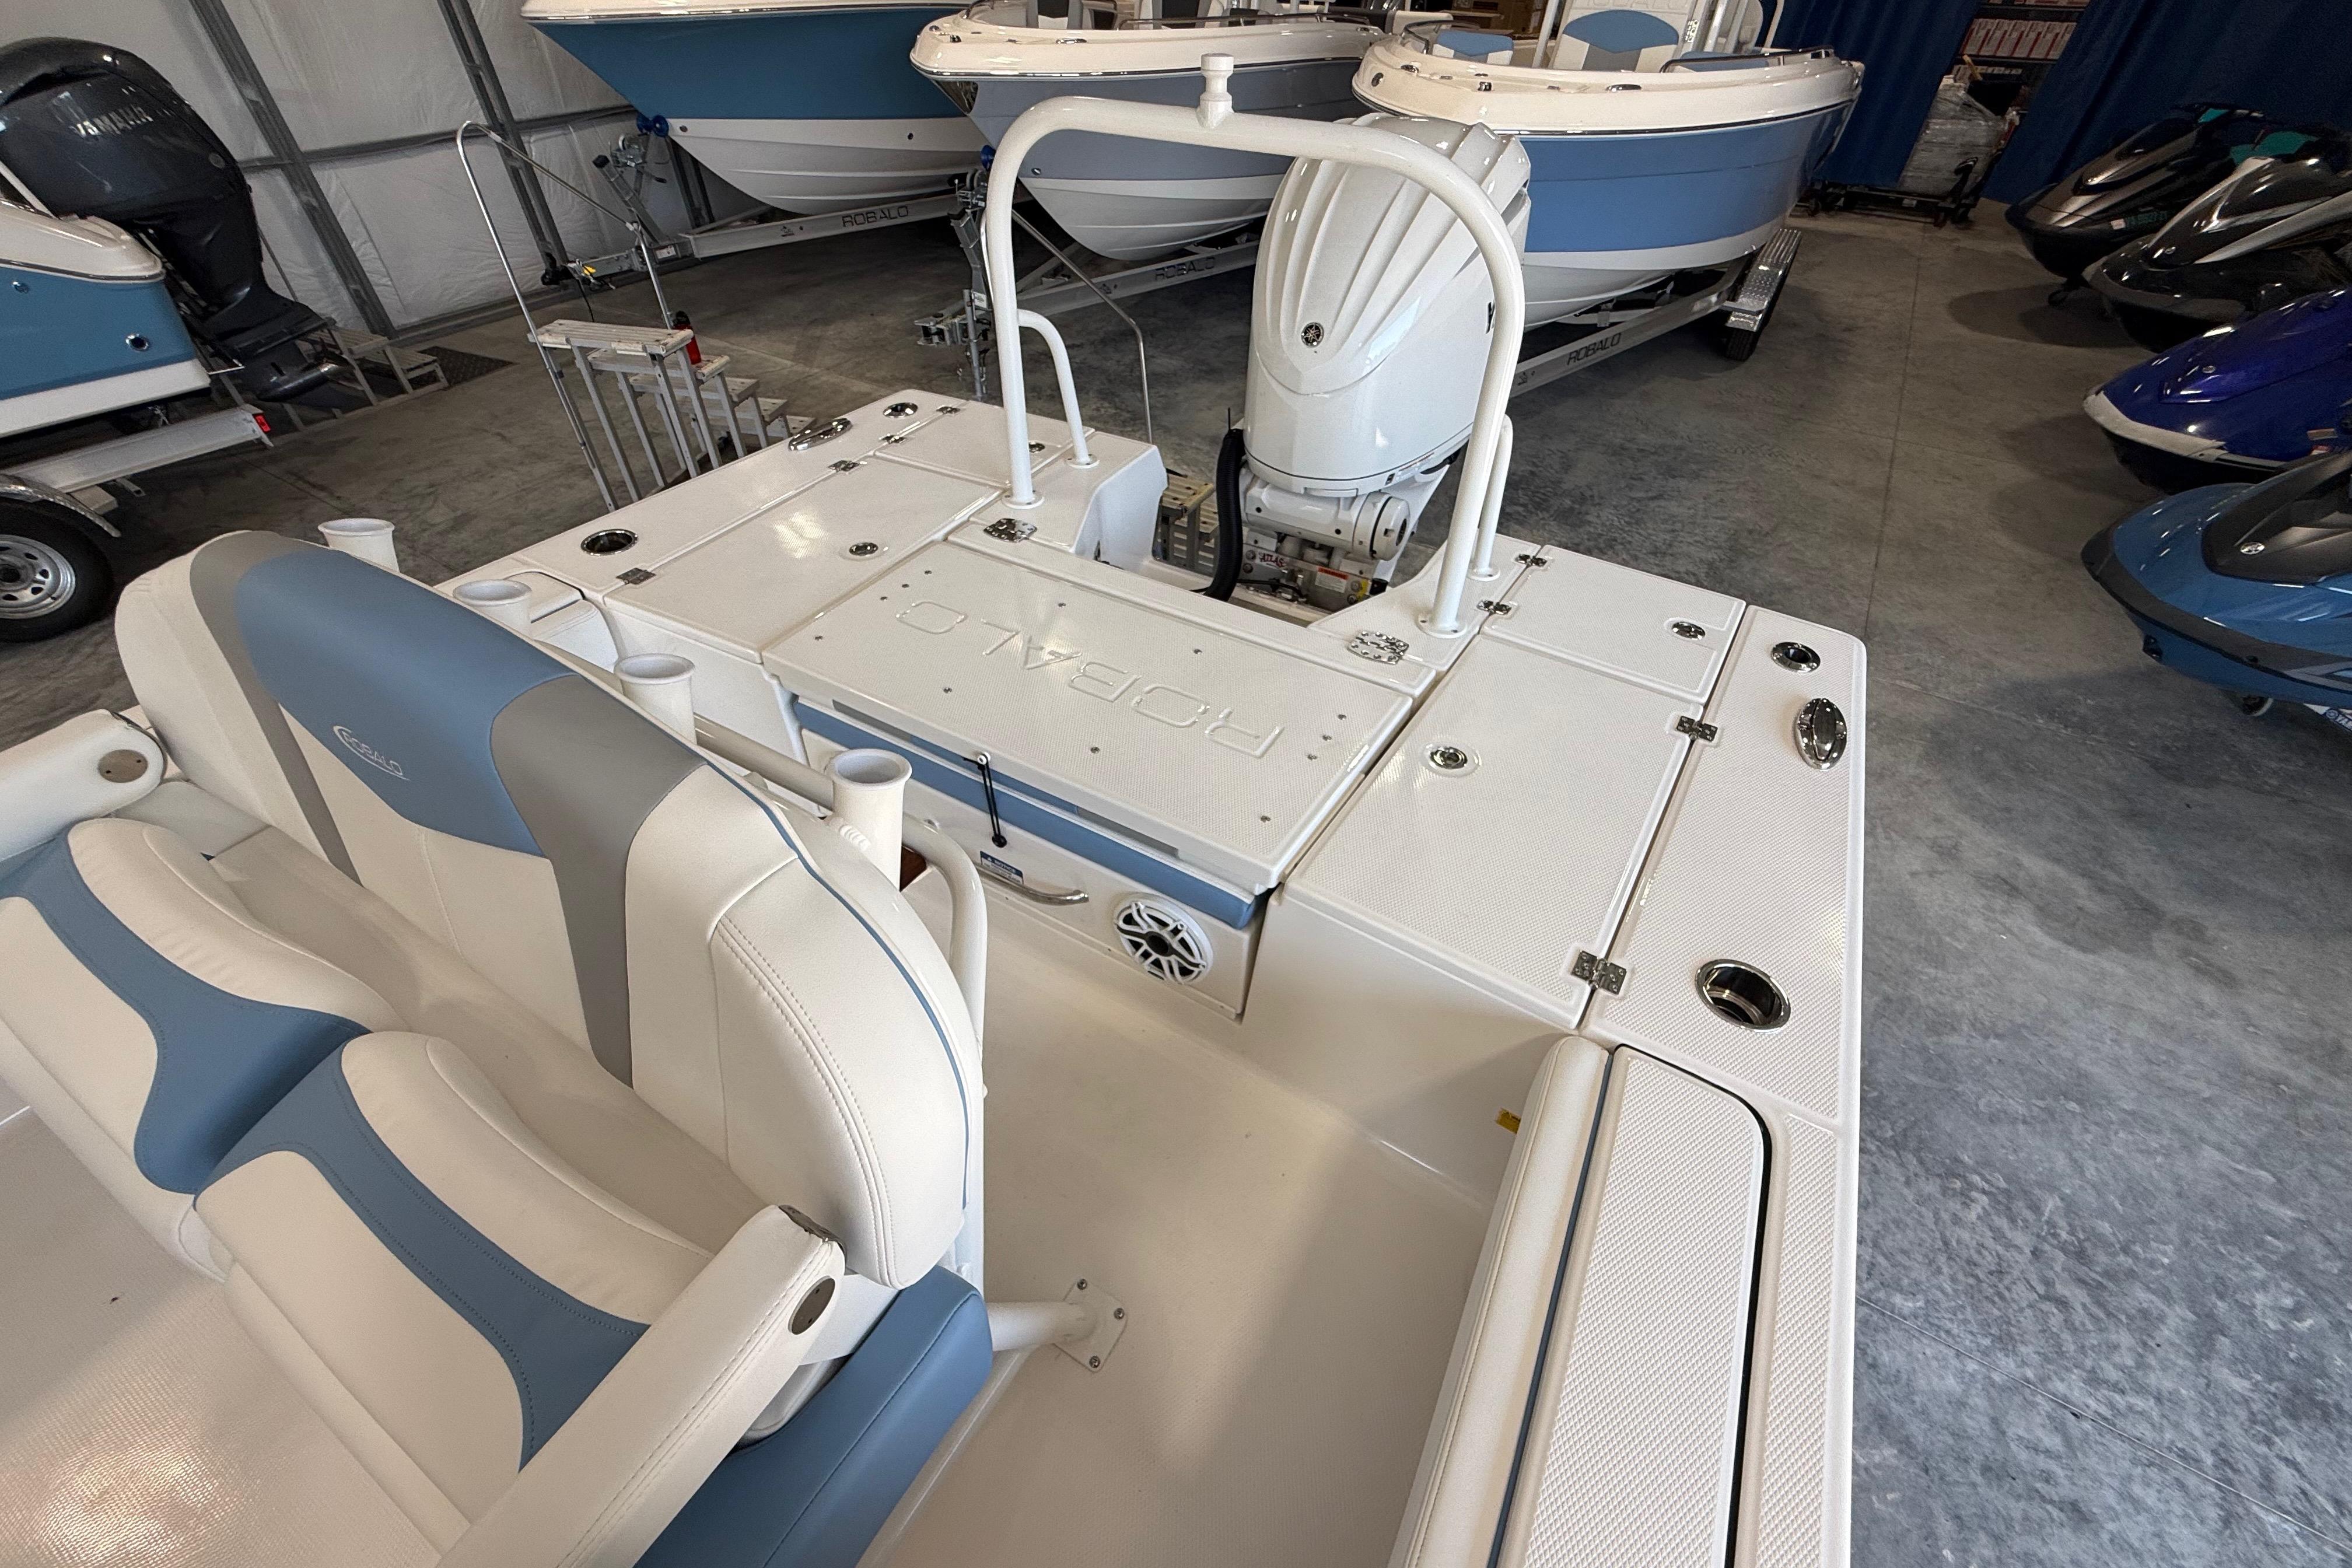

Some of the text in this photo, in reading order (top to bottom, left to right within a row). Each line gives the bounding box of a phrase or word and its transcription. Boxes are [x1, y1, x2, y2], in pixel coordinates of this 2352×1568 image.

[842, 205, 909, 227] ROBALO
[1154, 256, 1216, 281] ROBALO
[1567, 332, 1622, 366] ROBALO
[1259, 552, 1284, 568] ATLAS
[895, 600, 1284, 758] ROBALO
[342, 730, 403, 776] ROBALO
